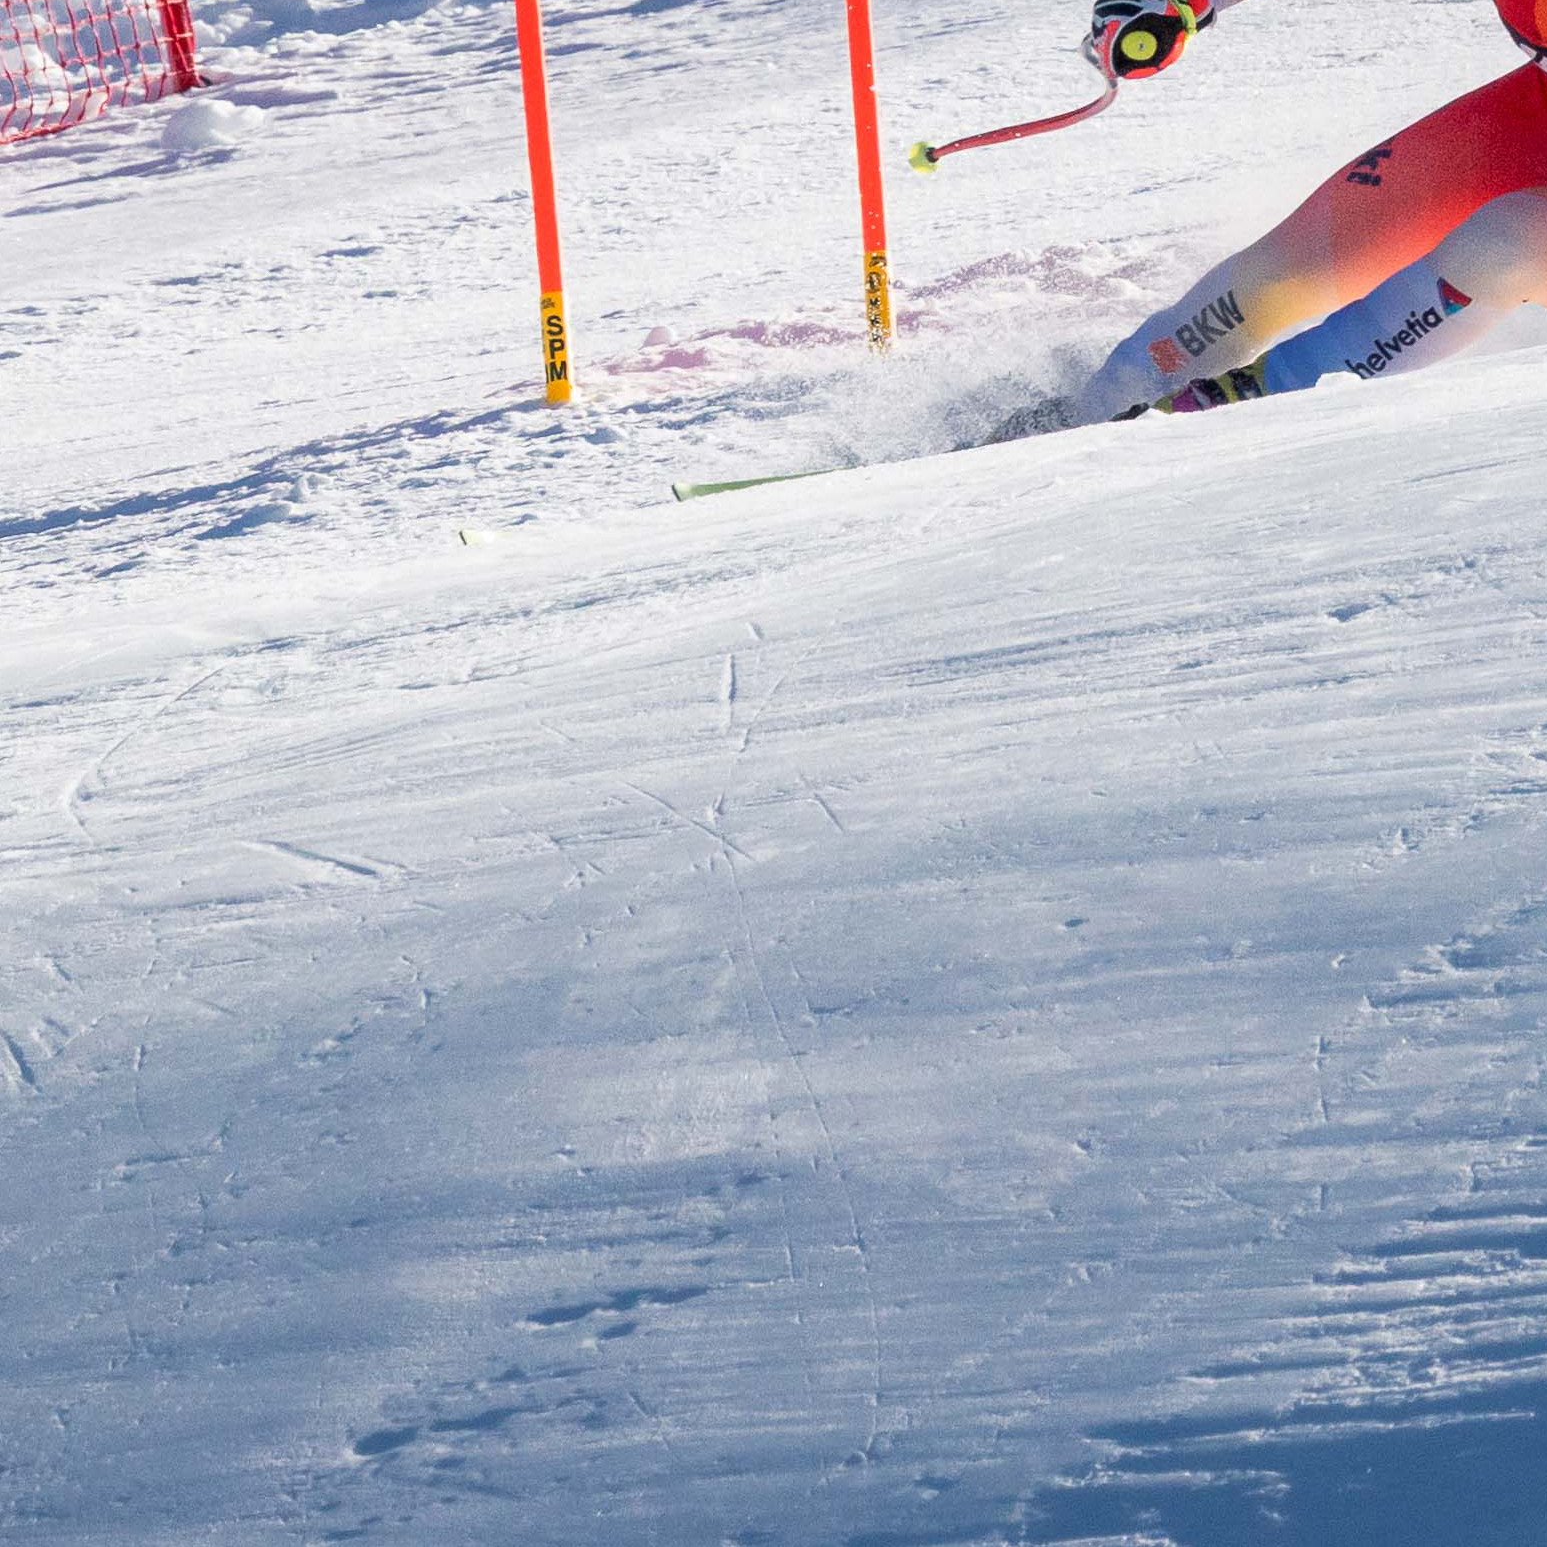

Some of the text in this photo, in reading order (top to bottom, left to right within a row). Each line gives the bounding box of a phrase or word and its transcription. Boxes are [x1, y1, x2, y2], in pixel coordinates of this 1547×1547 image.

[546, 314, 568, 382] SPM
[1175, 289, 1245, 358] BKW
[1344, 306, 1444, 380] helvetia
